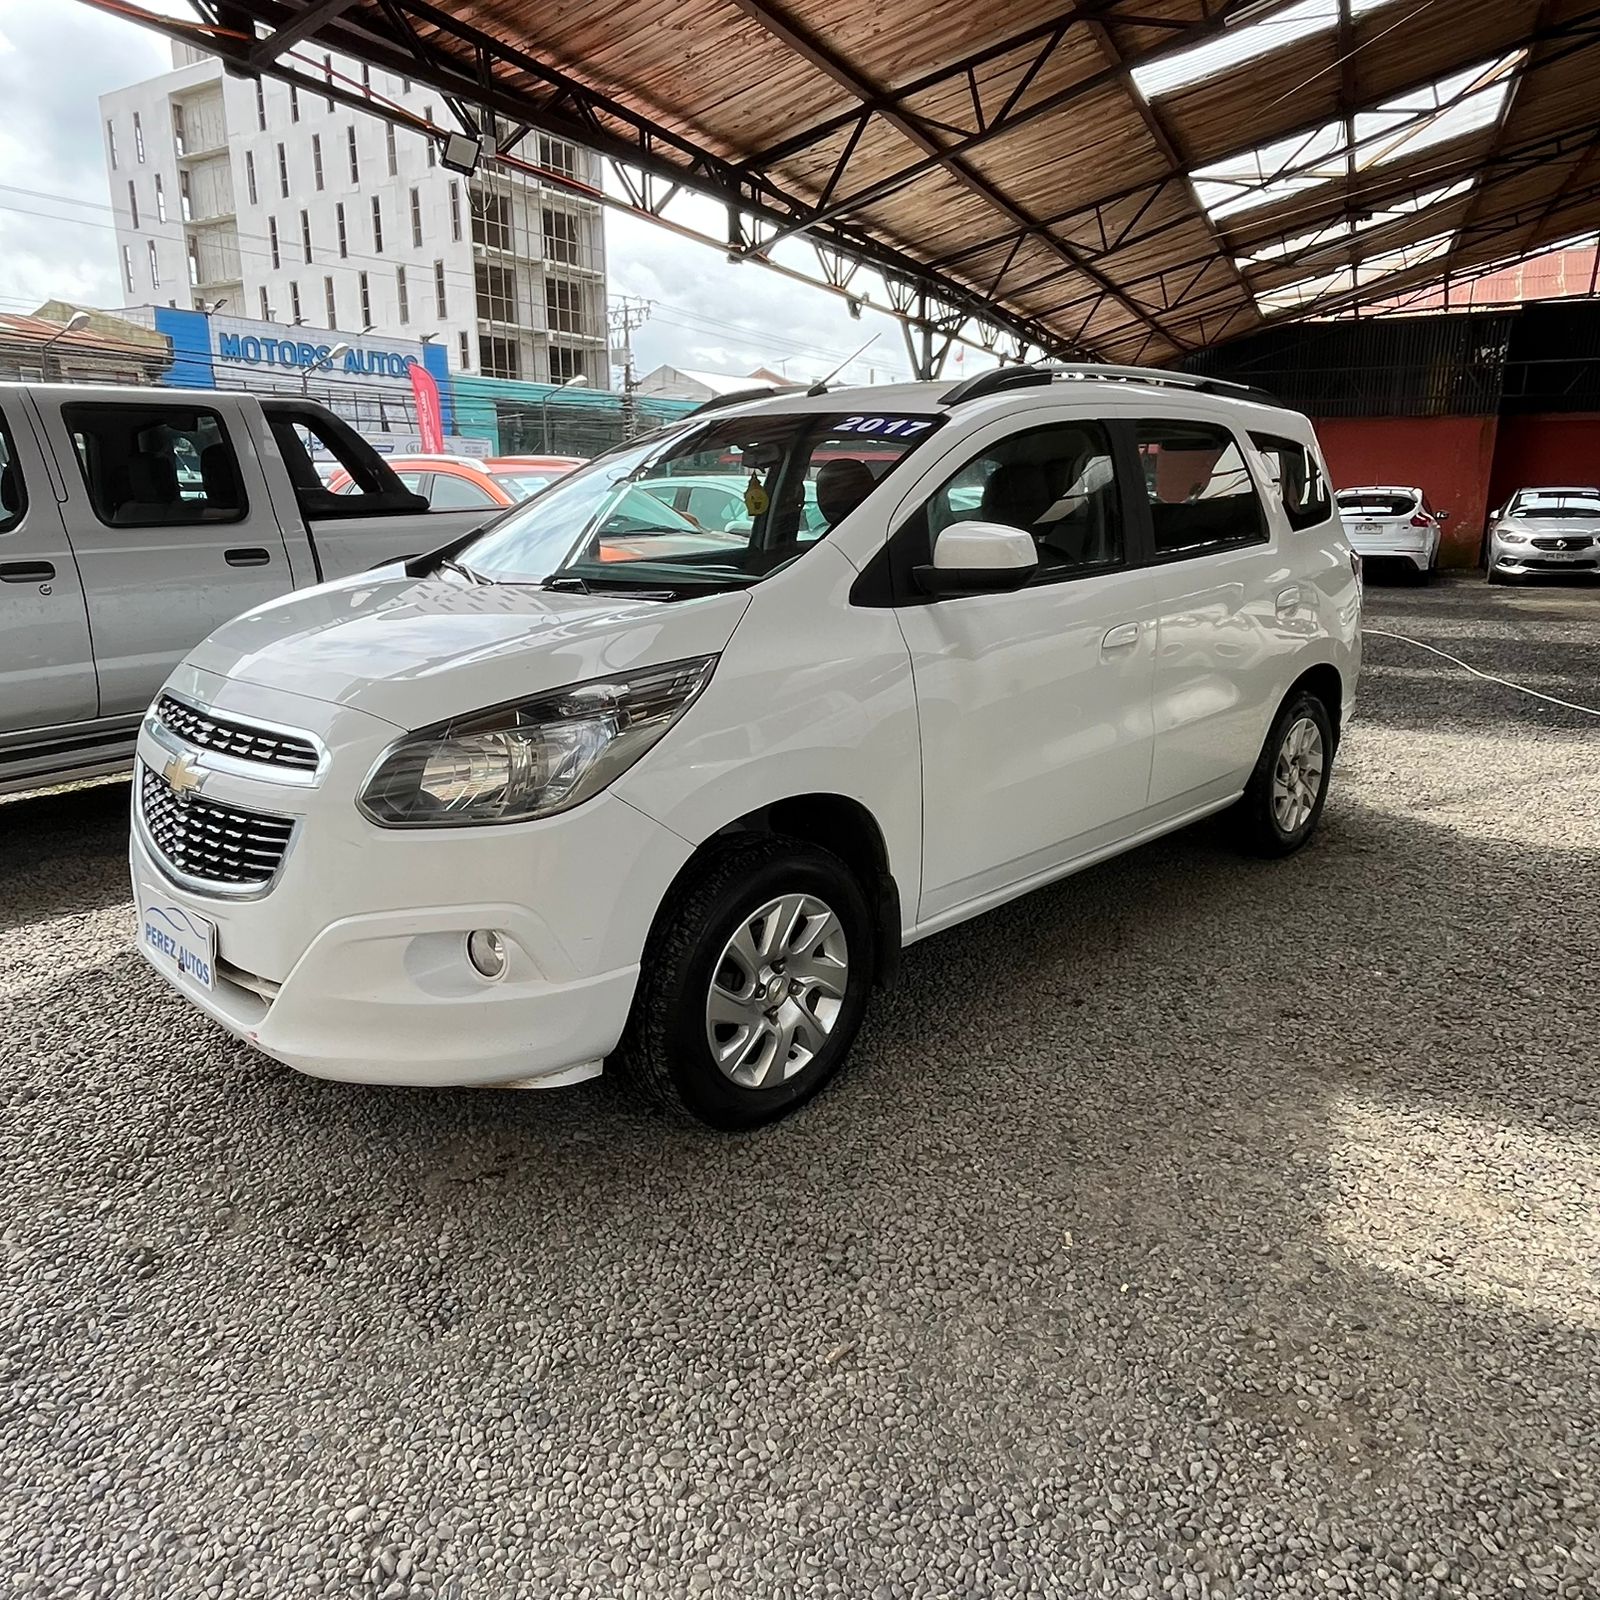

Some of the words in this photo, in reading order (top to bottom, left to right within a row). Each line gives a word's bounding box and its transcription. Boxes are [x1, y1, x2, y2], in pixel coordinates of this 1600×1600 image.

[219, 332, 334, 373] MOTORS
[344, 348, 418, 378] AUTOS
[833, 416, 933, 436] 2017
[145, 922, 177, 960] PEREZ
[177, 945, 210, 985] AUTOS
